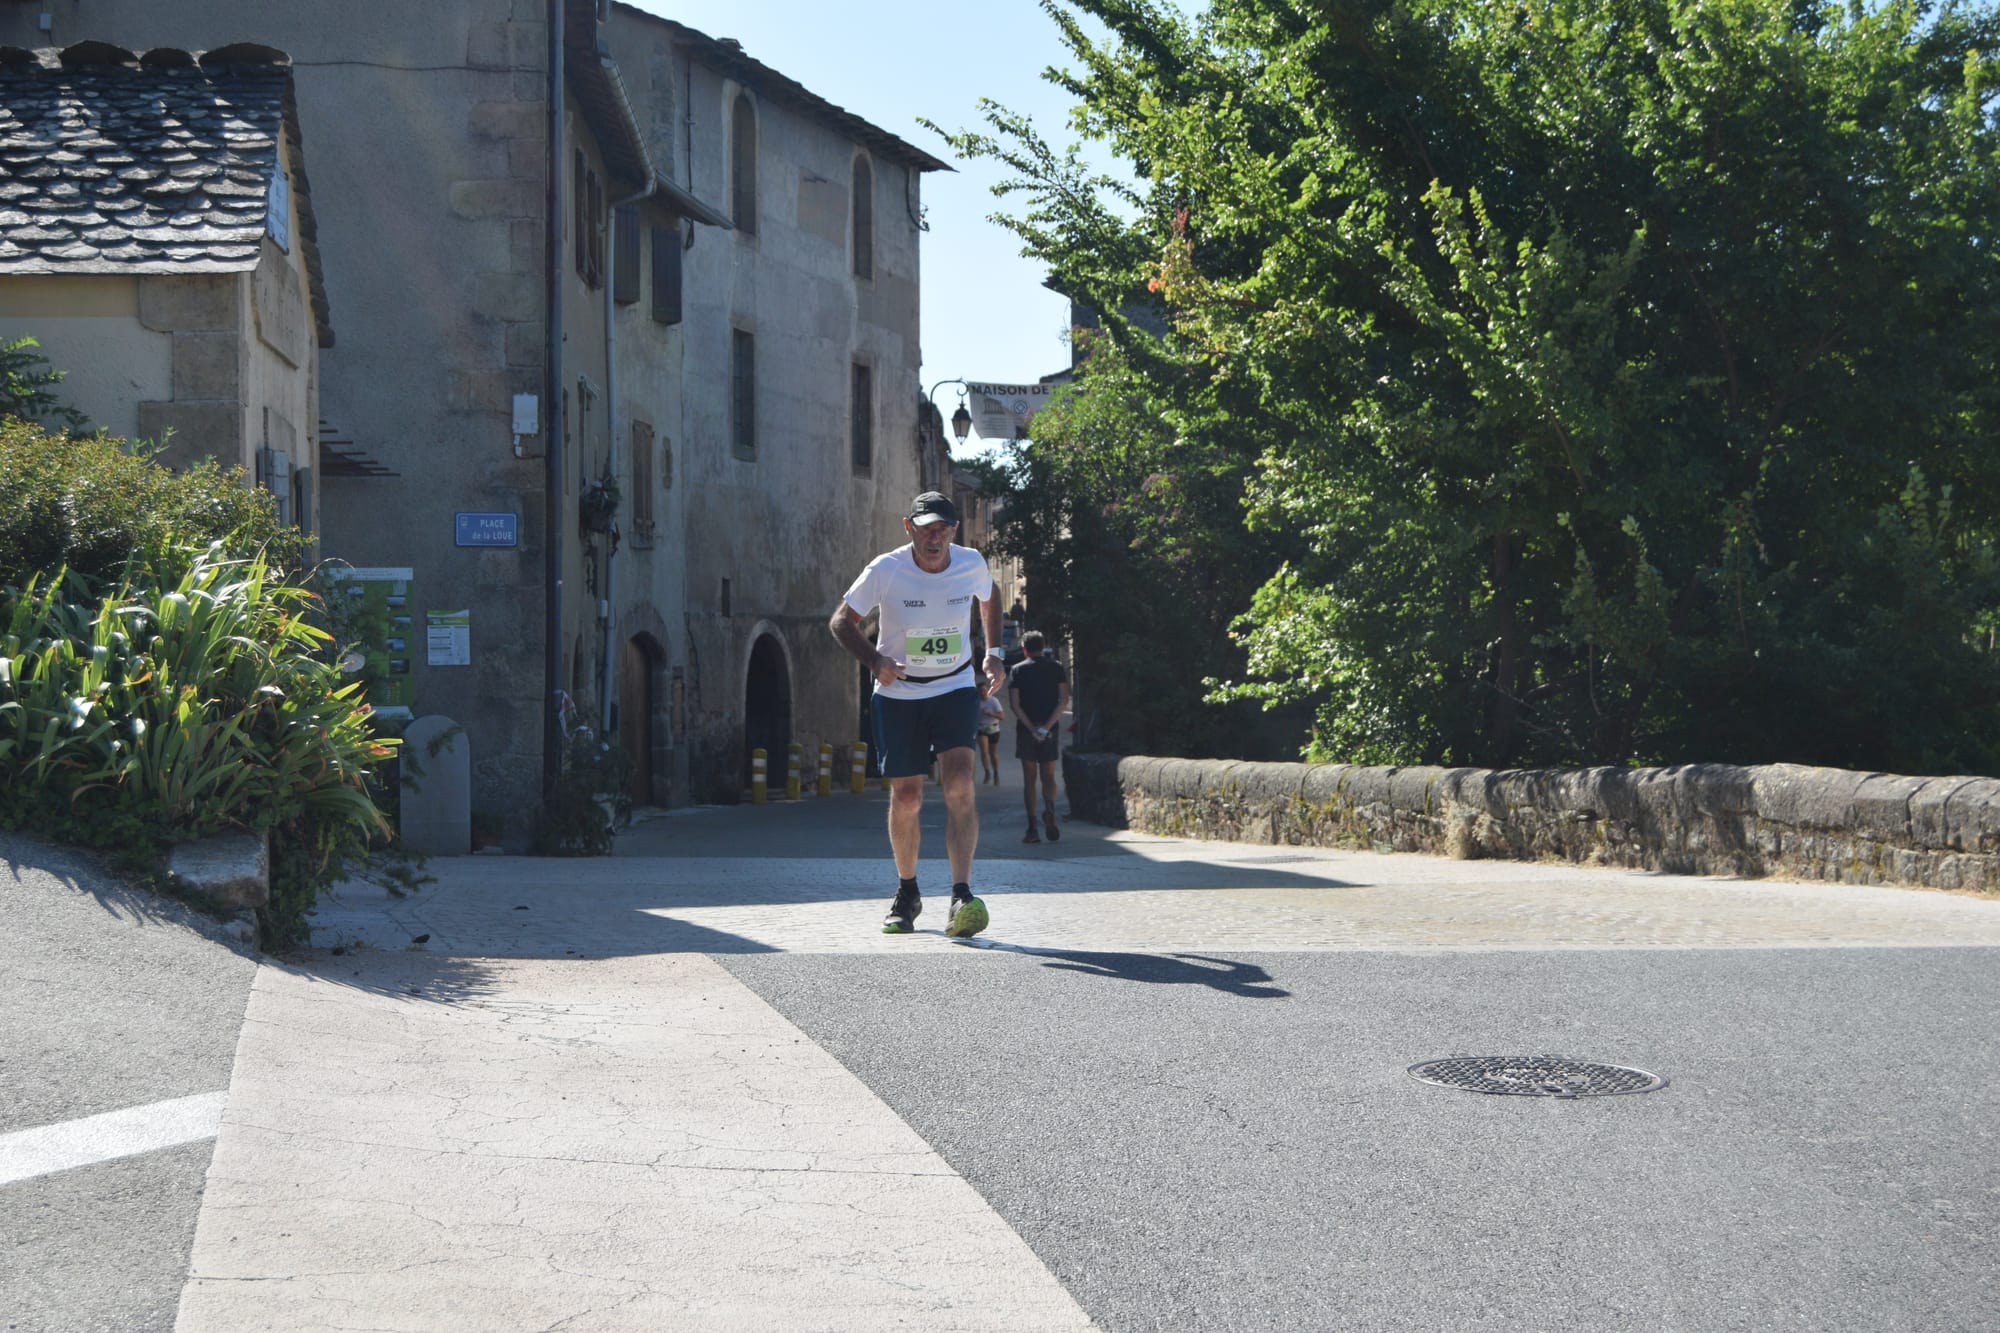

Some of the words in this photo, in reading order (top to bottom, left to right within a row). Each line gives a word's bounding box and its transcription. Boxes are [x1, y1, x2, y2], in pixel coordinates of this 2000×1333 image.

[971, 385, 1027, 395] MAISON
[1031, 386, 1050, 395] DE
[480, 519, 504, 528] PLACE
[472, 531, 481, 540] de
[492, 531, 512, 540] LOUE
[921, 638, 948, 655] 49
